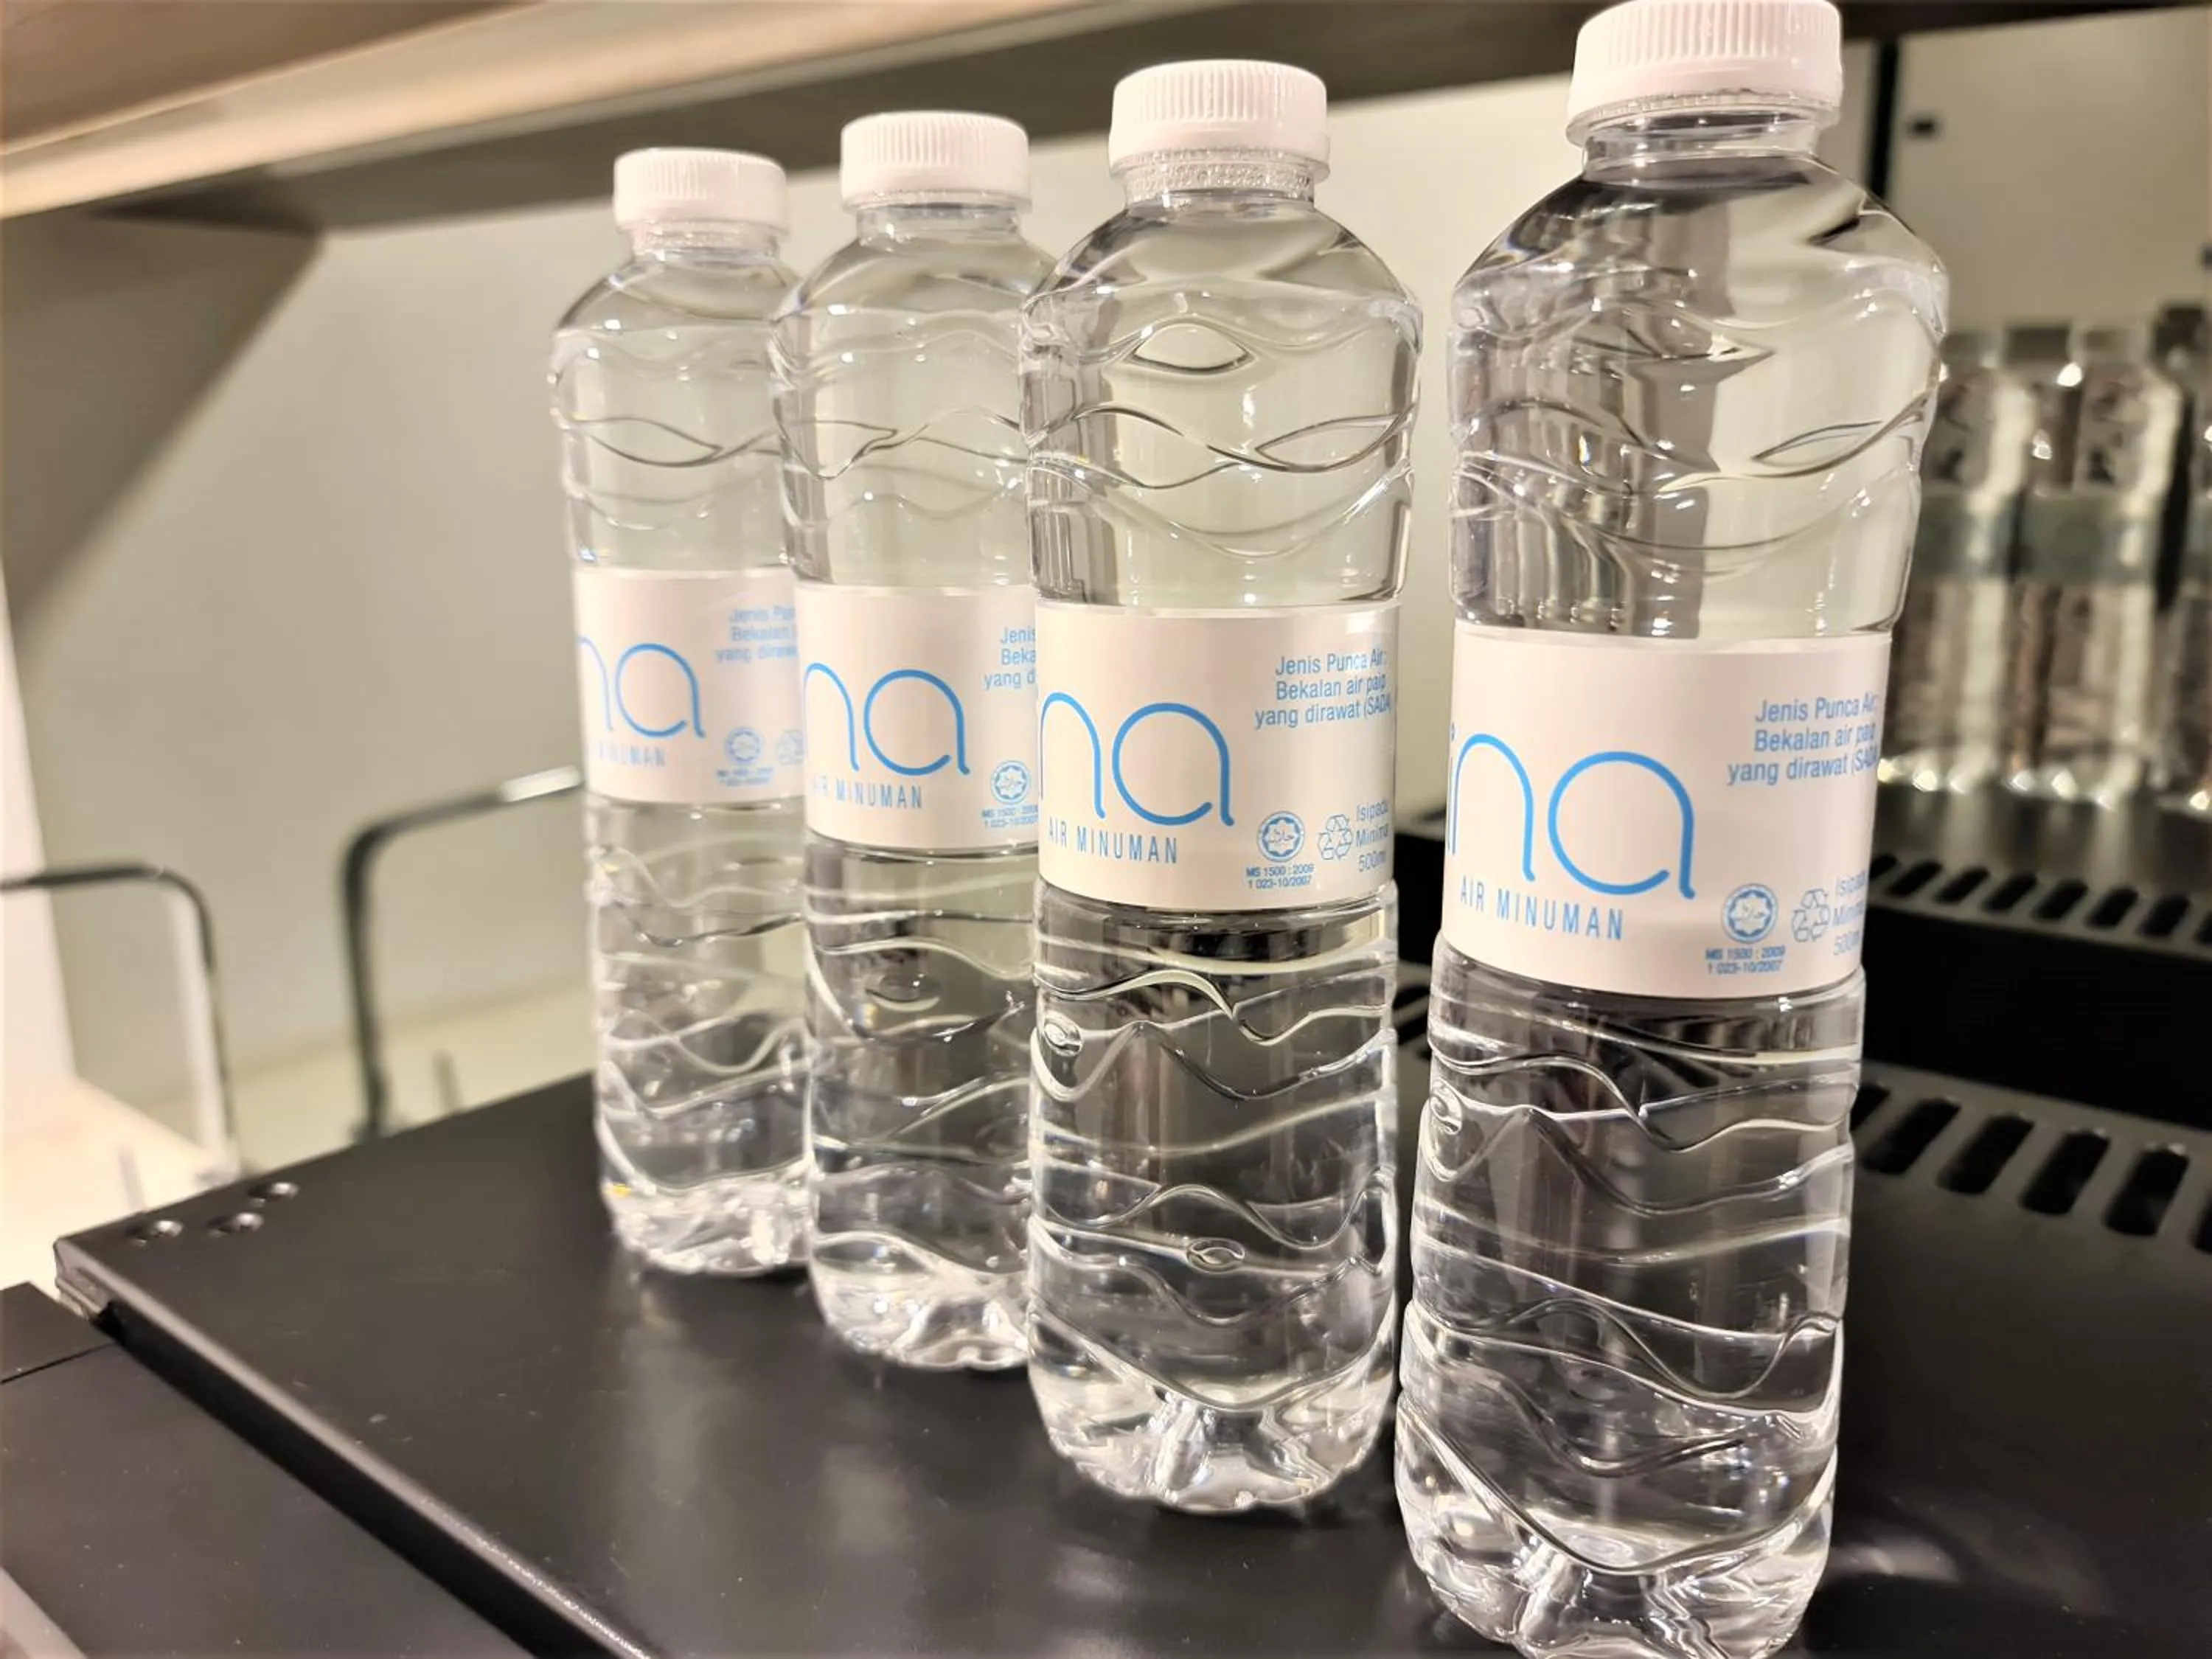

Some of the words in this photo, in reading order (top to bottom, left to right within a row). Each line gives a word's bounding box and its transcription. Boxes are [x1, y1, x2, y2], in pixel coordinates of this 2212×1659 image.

[1276, 655, 1321, 676] Jenis
[1327, 653, 1366, 672] Punca
[983, 672, 1021, 692] yang
[1276, 679, 1341, 700] Bekalan
[1346, 675, 1363, 695] air
[1255, 709, 1298, 730] yang
[1305, 700, 1360, 723] dirawat
[1754, 699, 1809, 723] Jenis
[1815, 697, 1859, 720] Punca
[1753, 727, 1830, 752] Bekalan
[1834, 724, 1853, 747] air
[1726, 762, 1779, 787] yang
[1786, 754, 1848, 781] dirawat
[835, 777, 922, 809] MINUMAN
[1048, 816, 1067, 848] AIR
[1077, 825, 1178, 864] MINUMAN
[1246, 866, 1260, 877] MS
[1460, 874, 1485, 913] AIR
[1496, 887, 1624, 941] MINUMAN
